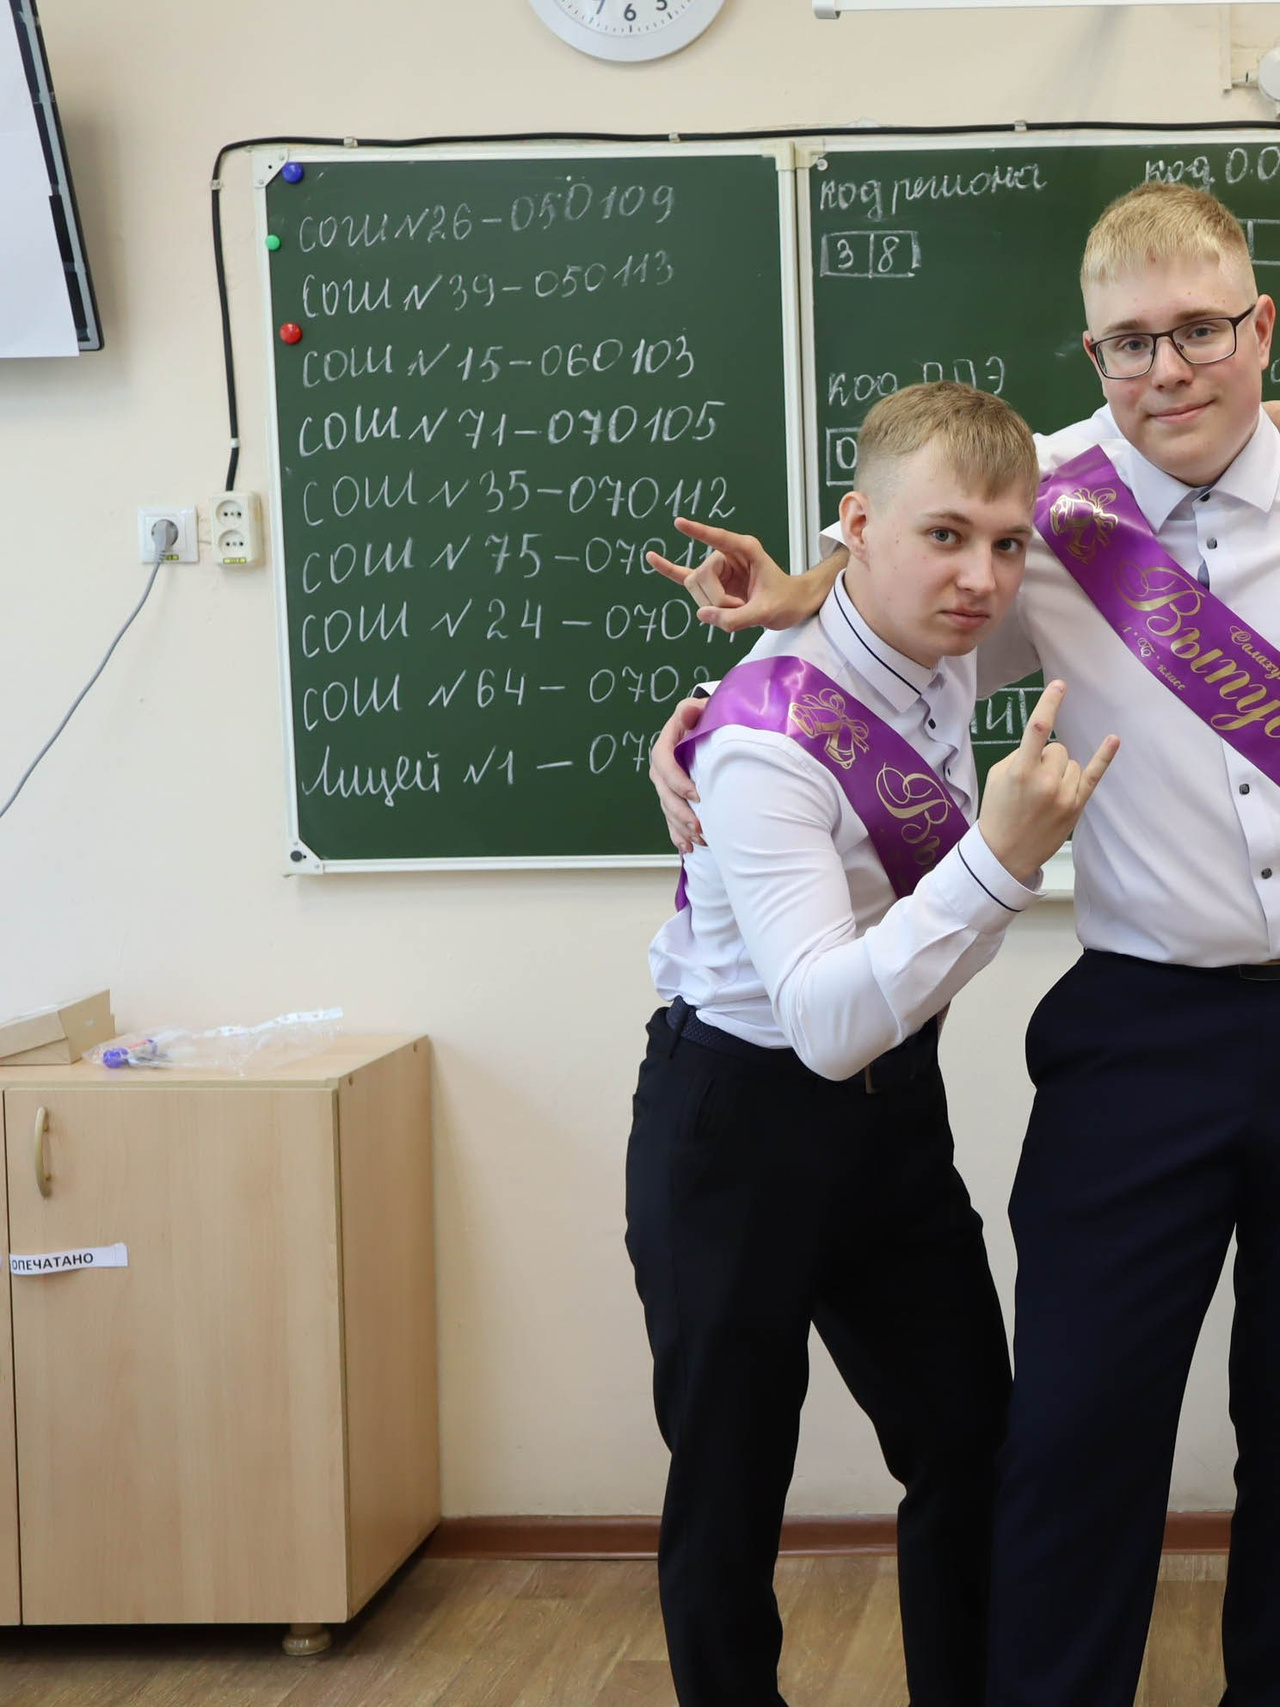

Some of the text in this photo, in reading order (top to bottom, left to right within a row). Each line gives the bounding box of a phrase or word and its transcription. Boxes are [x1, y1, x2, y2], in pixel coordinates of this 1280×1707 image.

[623, 3, 637, 21] 6
[819, 177, 884, 221] код
[11, 1252, 94, 1271] ОПЕЧАТАНО
